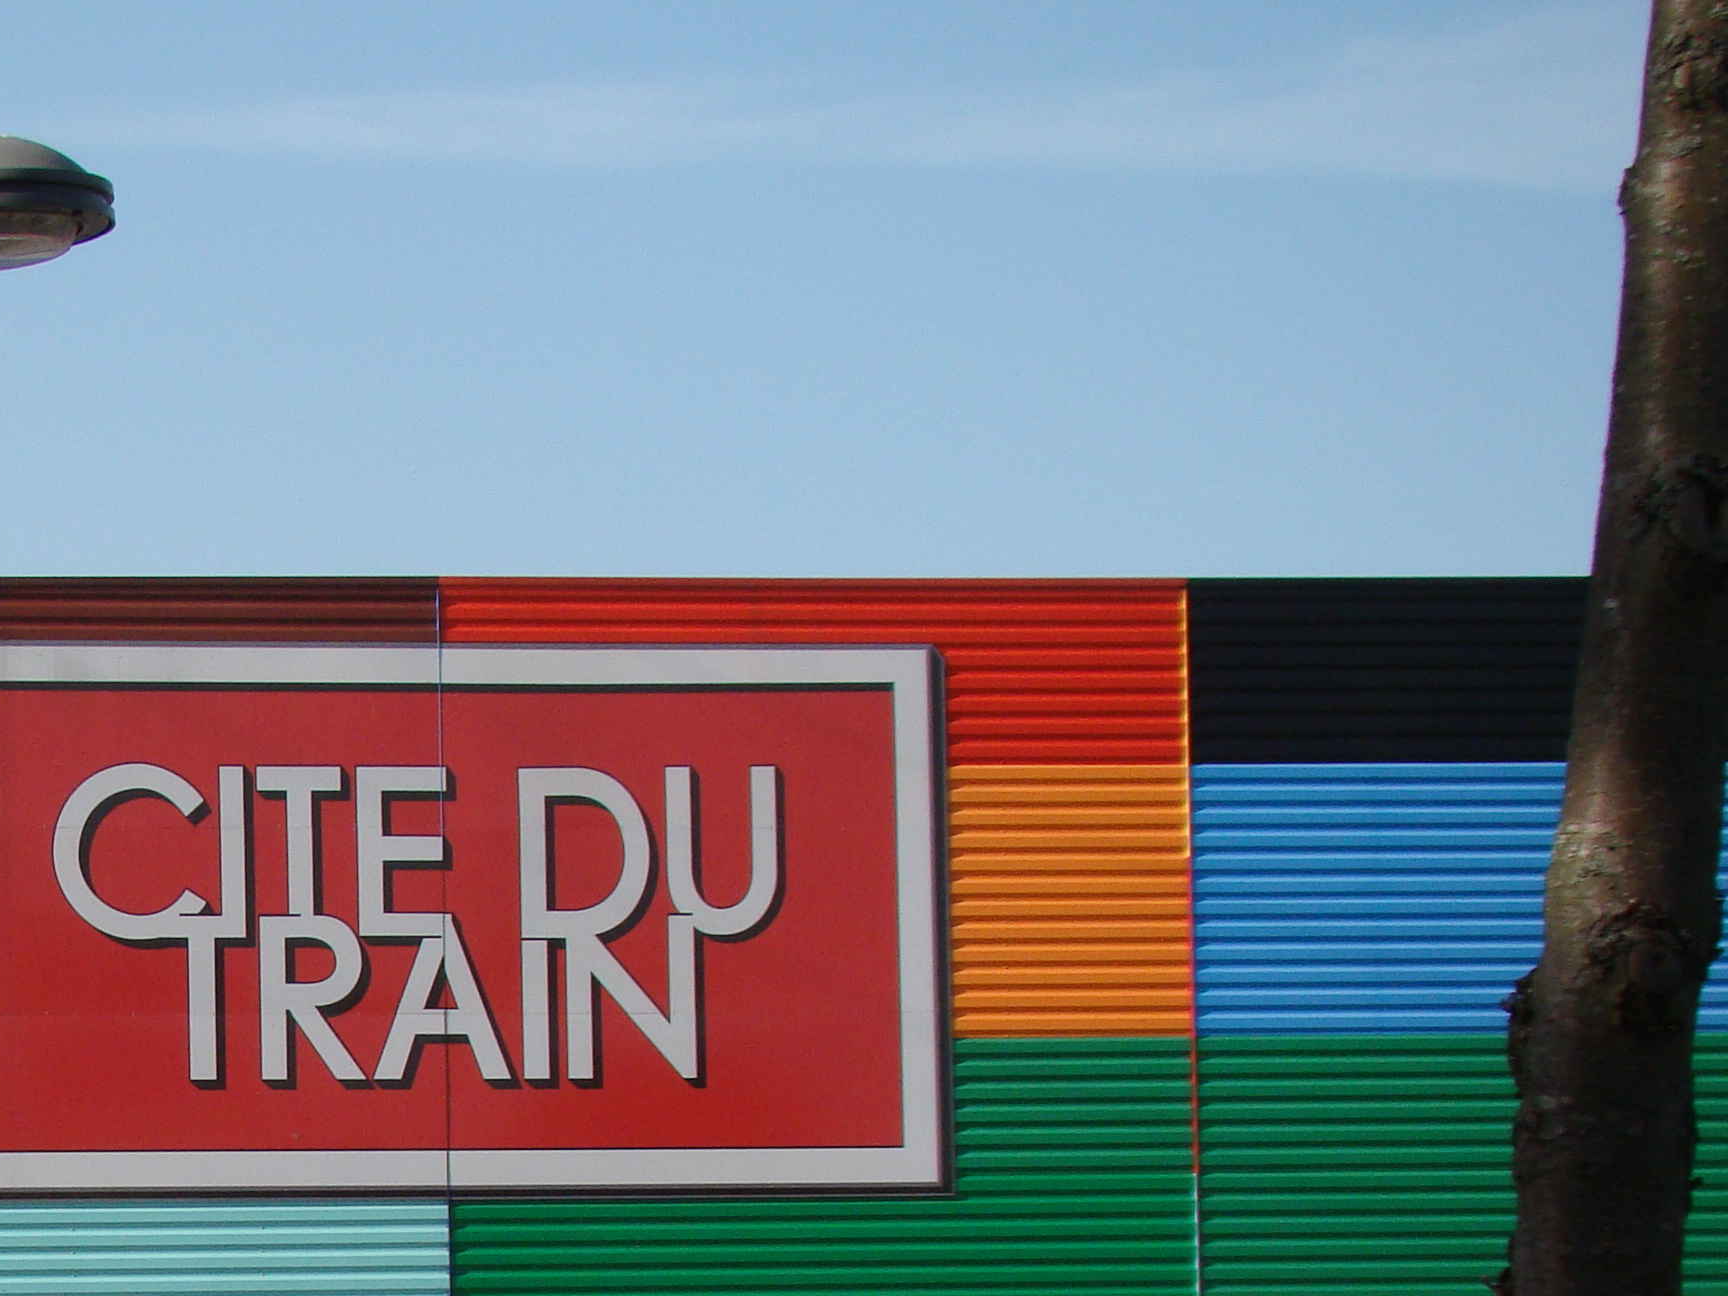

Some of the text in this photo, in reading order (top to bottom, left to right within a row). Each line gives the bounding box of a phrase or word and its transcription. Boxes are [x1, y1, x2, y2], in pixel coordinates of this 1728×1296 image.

[52, 762, 784, 941] CITE DU
[179, 912, 706, 1088] TRAIN
